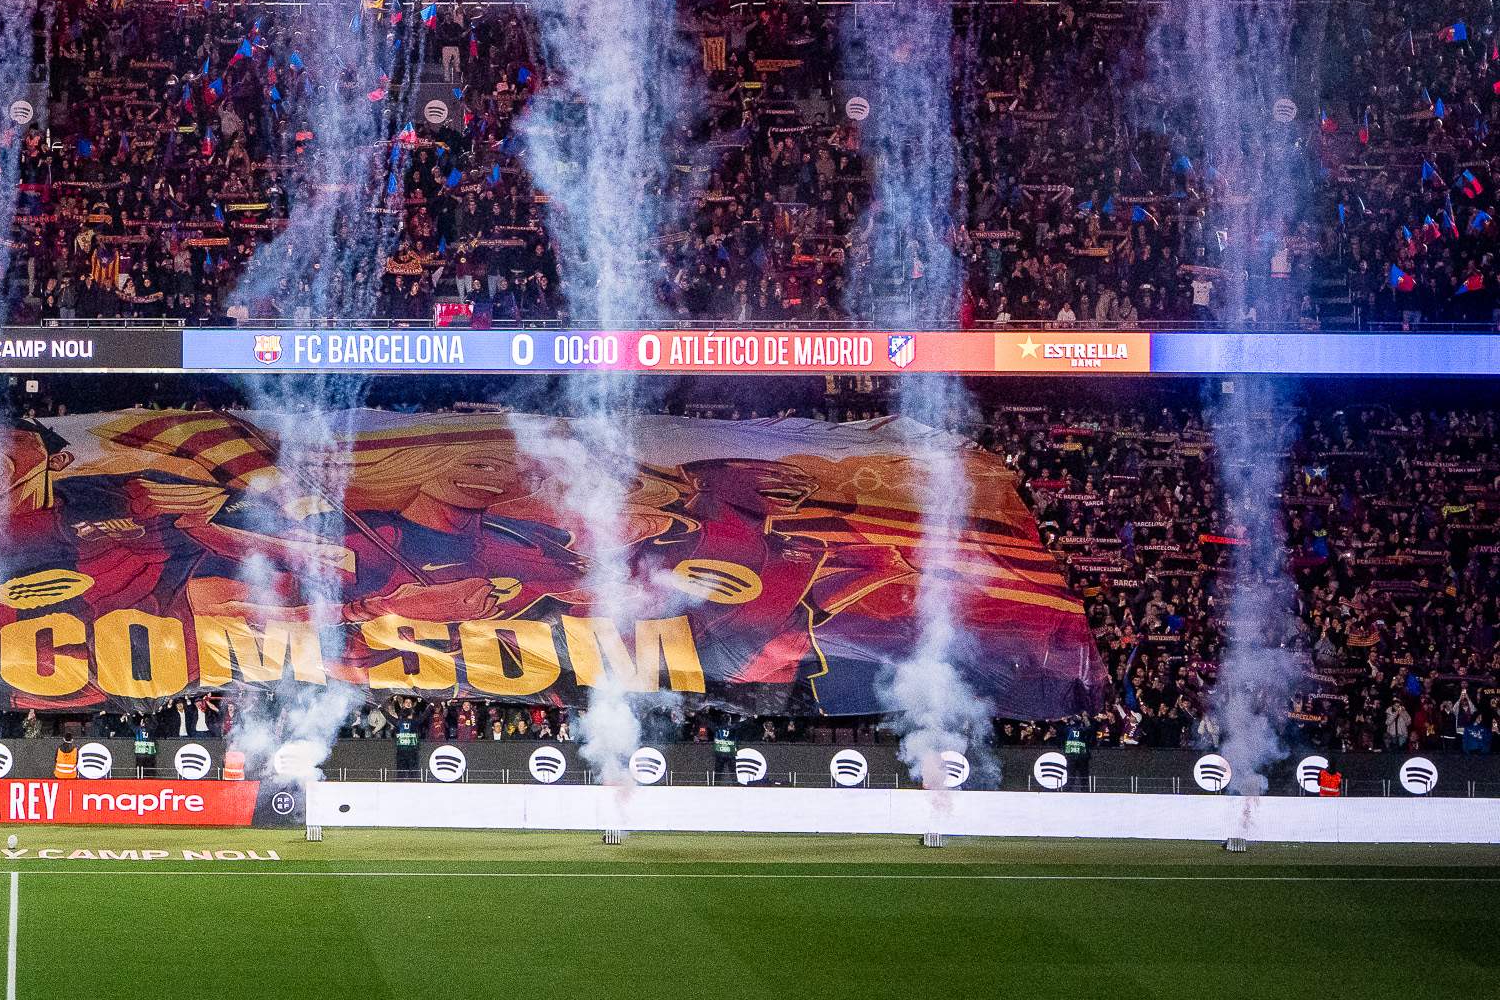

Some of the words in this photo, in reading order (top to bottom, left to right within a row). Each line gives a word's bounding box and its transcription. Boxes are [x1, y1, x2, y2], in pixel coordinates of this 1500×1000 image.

[51, 339, 93, 359] NOU
[294, 334, 324, 363] FC
[328, 334, 465, 363] BARCELONA
[511, 333, 534, 366] 0
[554, 335, 618, 365] 00:00
[638, 334, 661, 366] 0
[669, 331, 759, 366] ATLÉTICO
[764, 337, 789, 366] DE
[793, 337, 873, 366] MADRID
[1043, 342, 1129, 360] ESTRELLA
[1070, 359, 1101, 368] DAMM
[1114, 579, 1138, 587] BARÇA
[0, 608, 328, 700] COM
[361, 613, 707, 700] SOM
[9, 782, 60, 821] REY
[82, 787, 205, 816] mapfre
[38, 848, 170, 861] CAMP
[182, 849, 282, 862] NOU
